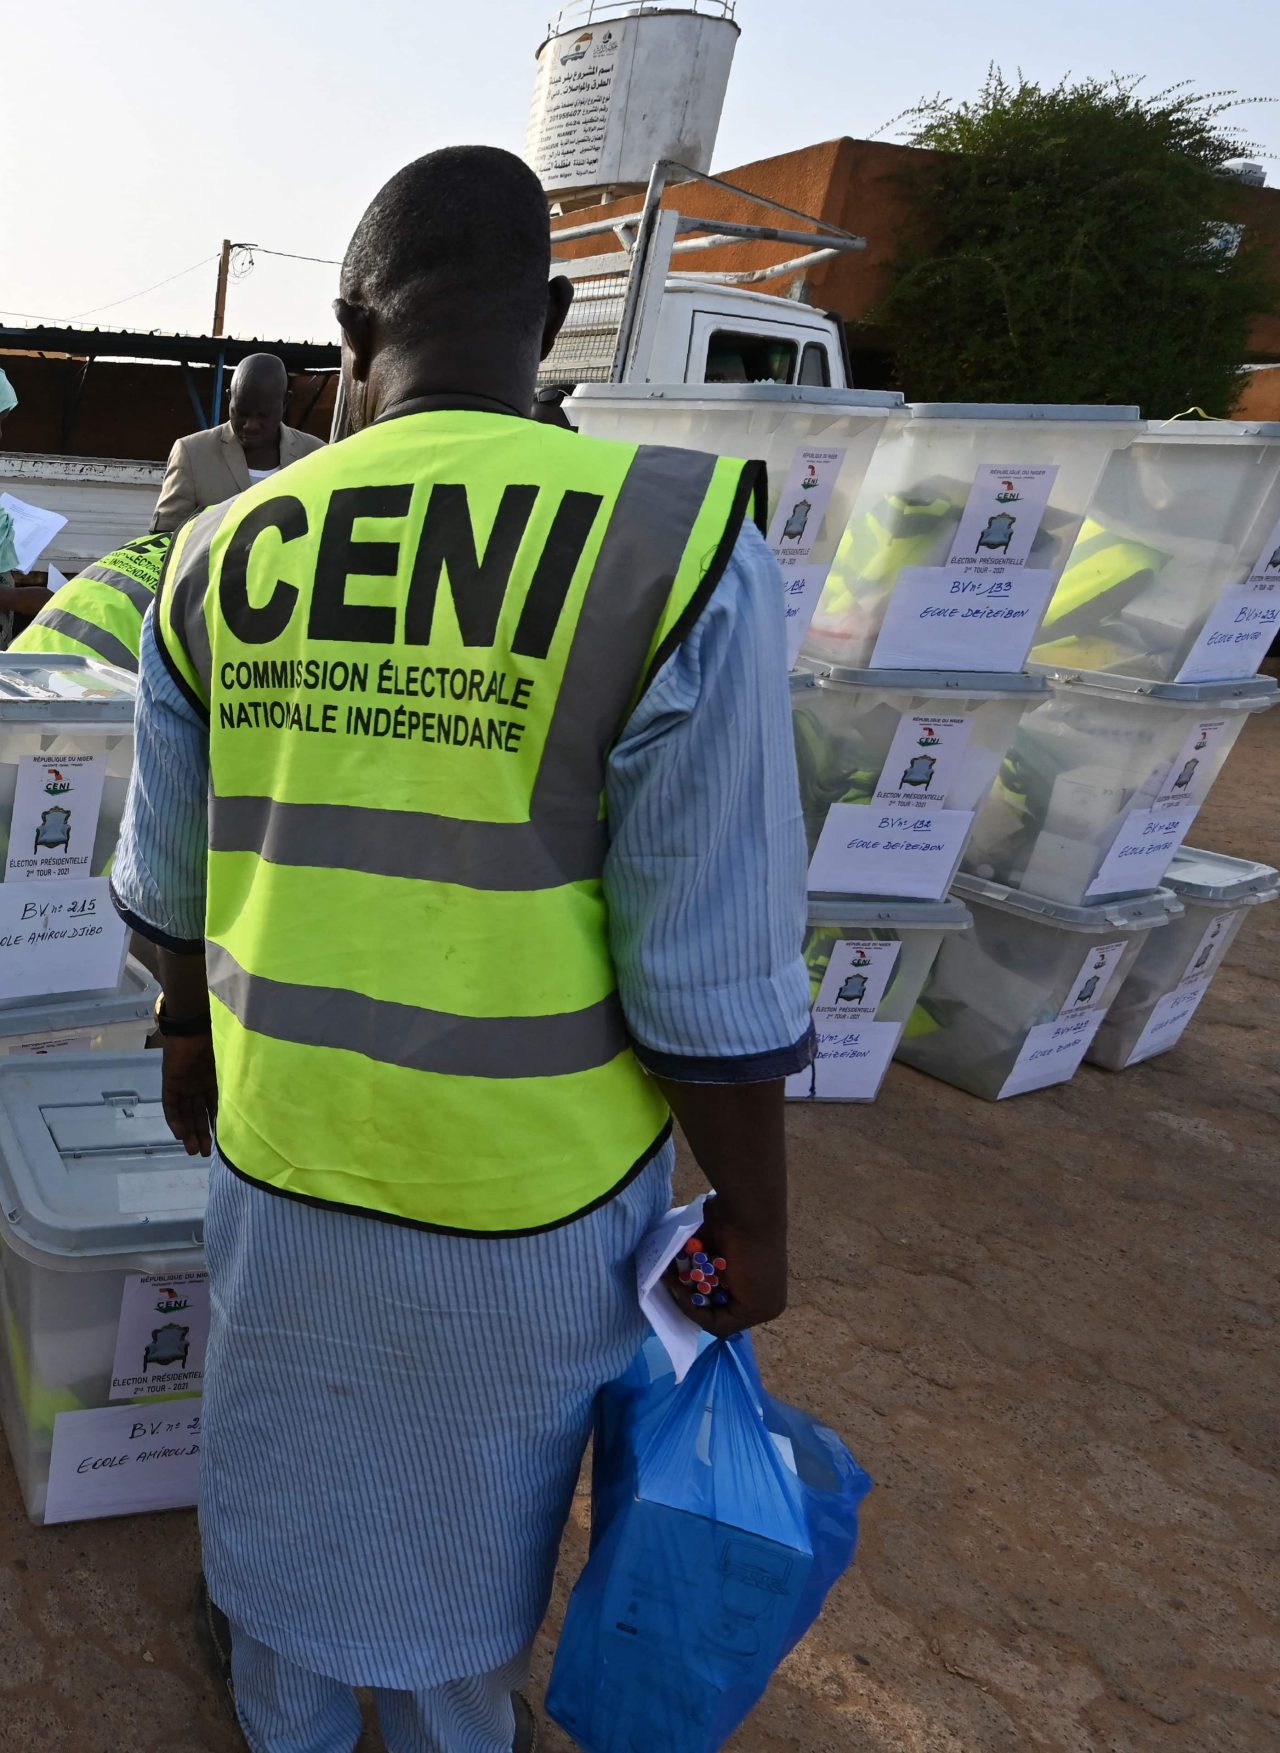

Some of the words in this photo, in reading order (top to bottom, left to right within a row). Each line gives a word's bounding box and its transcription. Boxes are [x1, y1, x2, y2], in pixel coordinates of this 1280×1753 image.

[219, 482, 604, 660] CENI
[220, 659, 369, 693] COMMISSION
[376, 658, 534, 711] ÉLECTORALE
[219, 700, 340, 734] NATIONALE
[346, 703, 526, 754] INDÉPENDANTE
[46, 782, 70, 790] CENI
[9, 859, 38, 868] ÉLECTION
[40, 856, 88, 866] PRÉSIDENTIELLE
[37, 869, 52, 877] TOUR
[57, 868, 70, 876] 2021
[67, 899, 97, 914] 215
[157, 1299, 188, 1308] CENI
[112, 1377, 148, 1387] ÉLECTION
[151, 1371, 204, 1383] PRÉSIDENTIEL
[147, 1384, 166, 1393] TOUR
[76, 1455, 130, 1474] ECOLE
